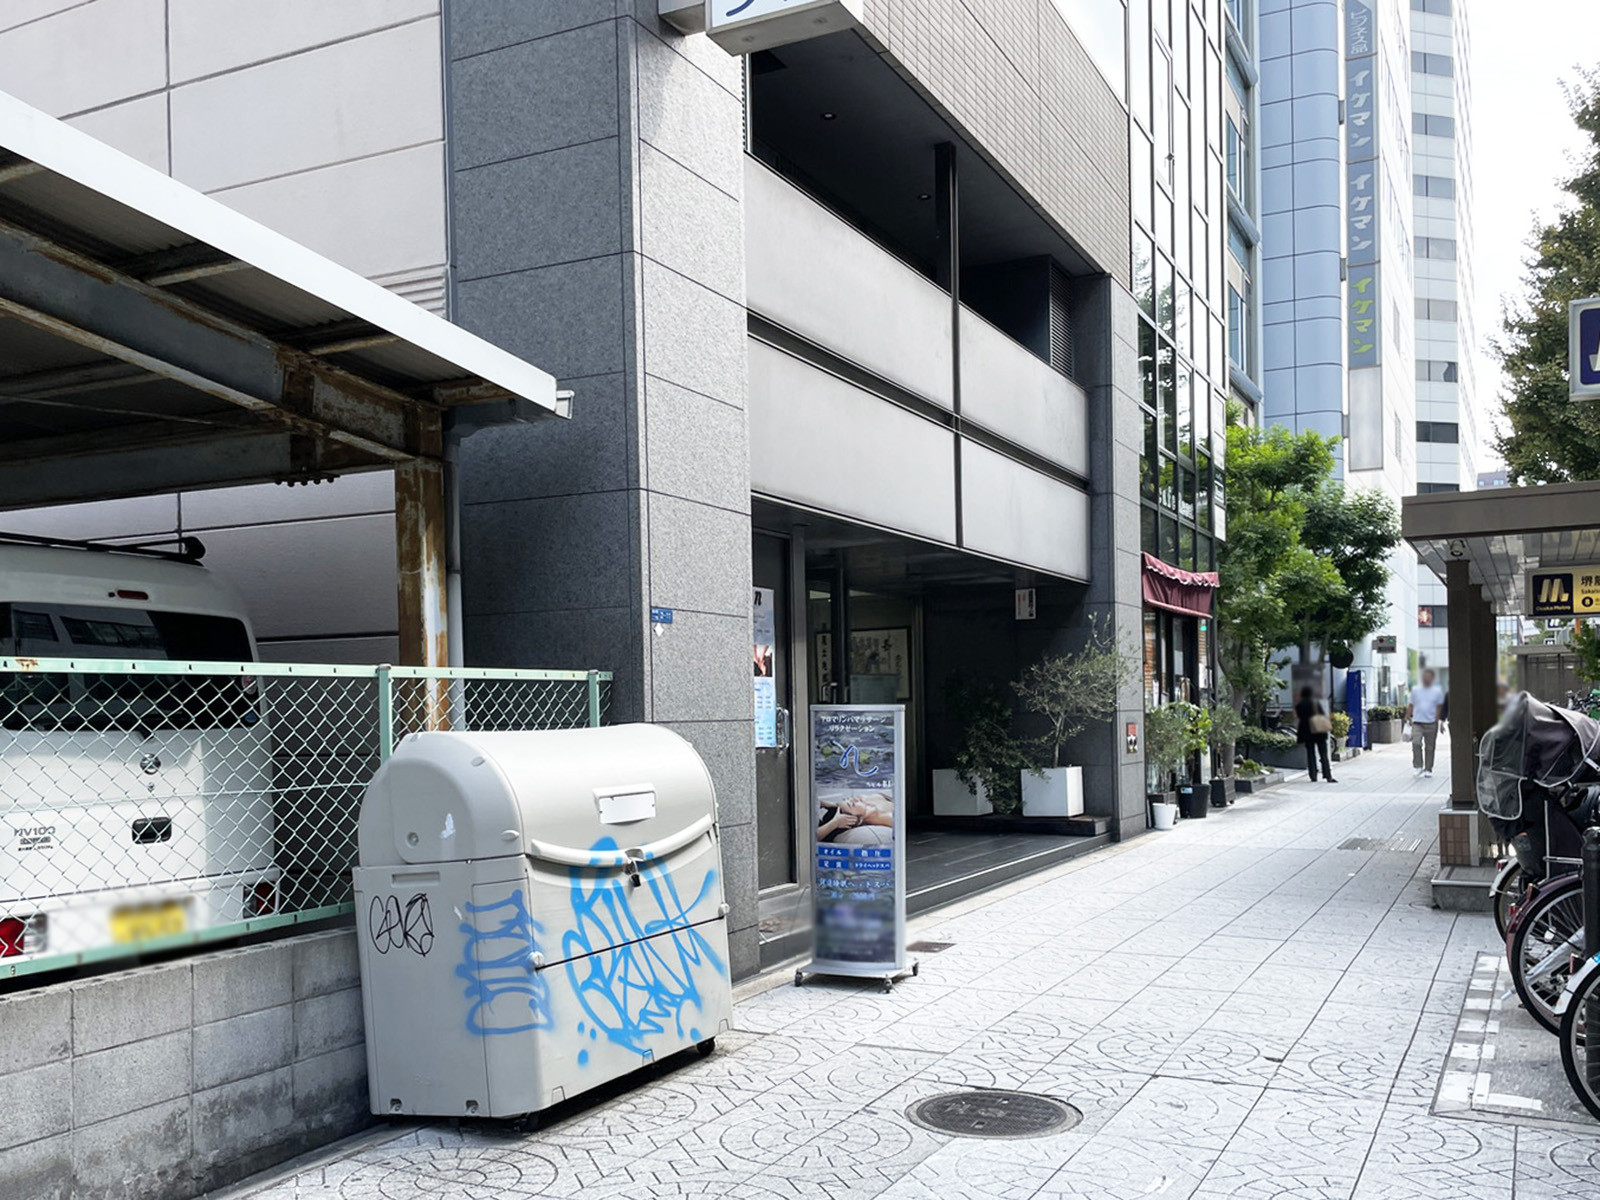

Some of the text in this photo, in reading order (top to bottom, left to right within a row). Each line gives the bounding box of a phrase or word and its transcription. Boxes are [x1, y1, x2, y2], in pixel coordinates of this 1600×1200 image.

[1350, 69, 1372, 149] イケマン
[1350, 173, 1373, 251] イケマン
[1351, 277, 1374, 354] イケマン
[828, 725, 875, 733] リラクゼーション
